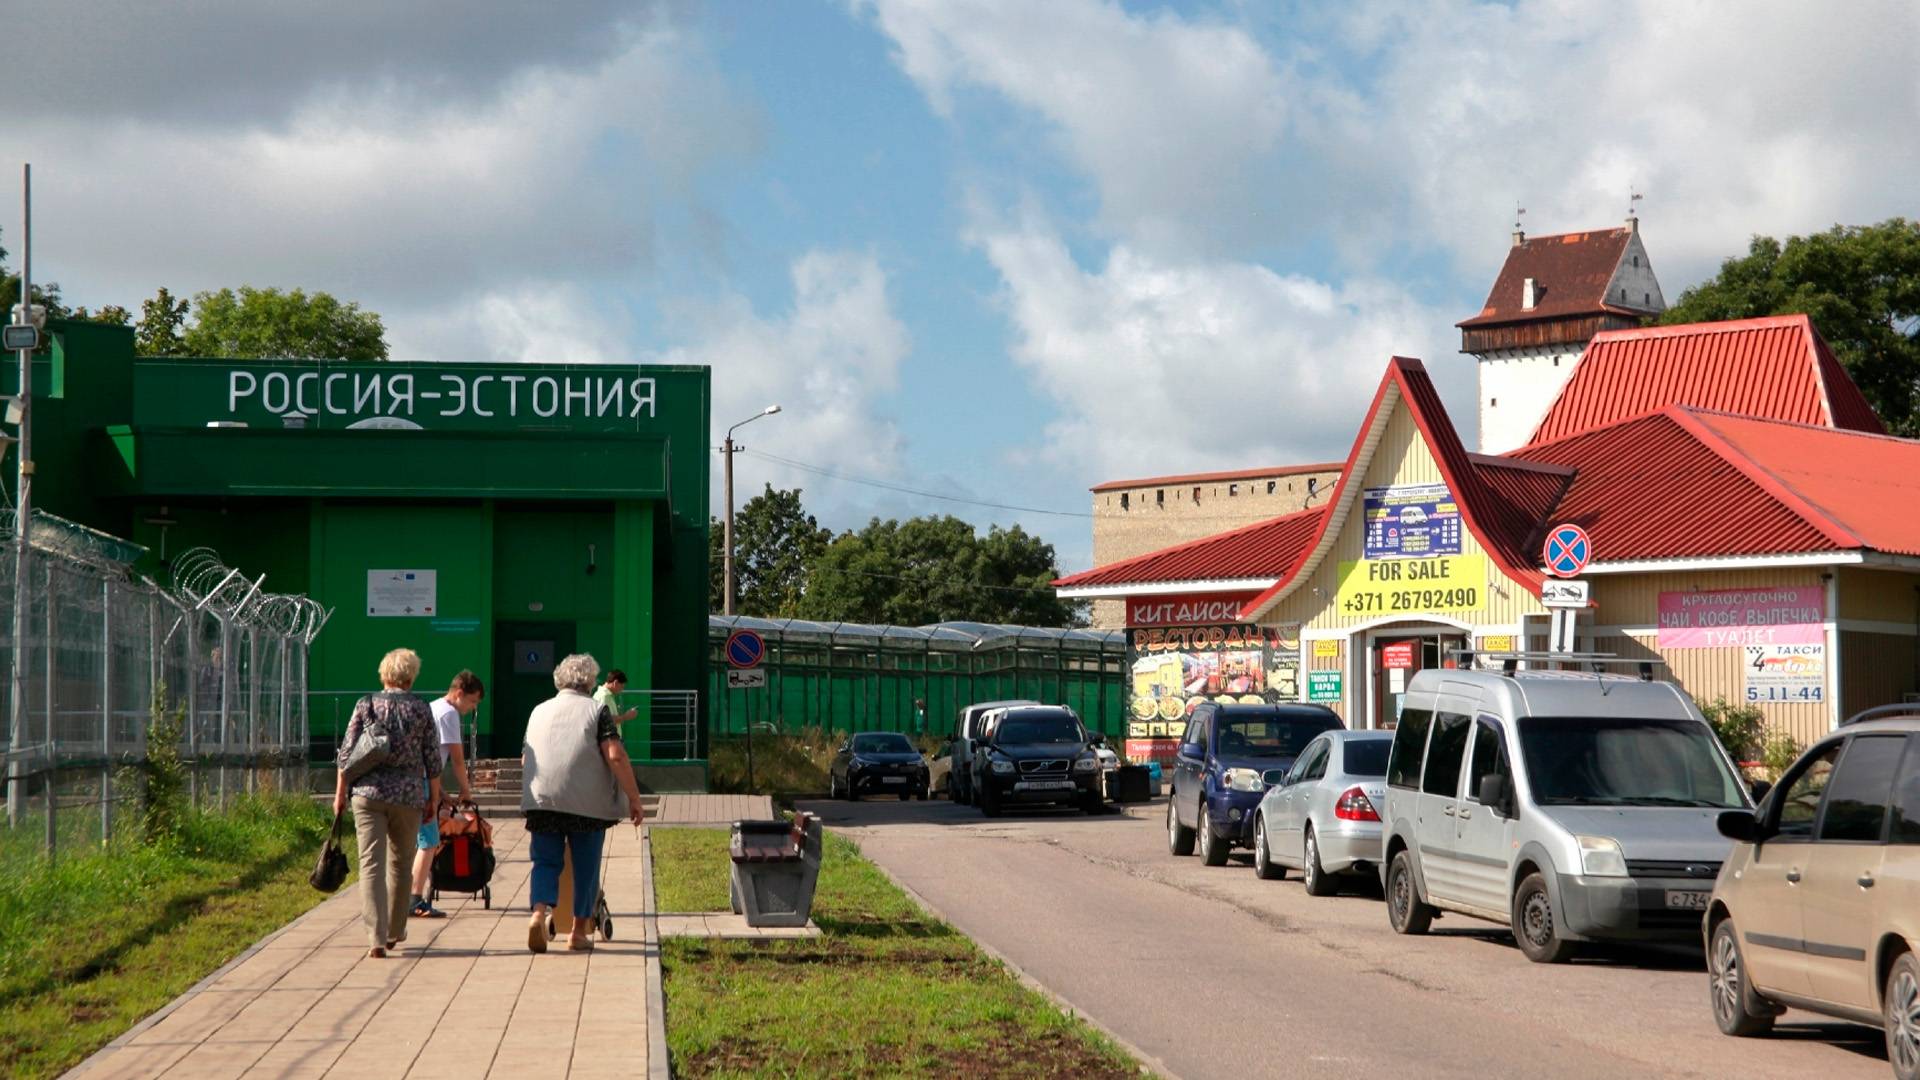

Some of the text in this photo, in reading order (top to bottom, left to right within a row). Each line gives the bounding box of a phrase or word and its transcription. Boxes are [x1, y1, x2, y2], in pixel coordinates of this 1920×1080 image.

[229, 370, 657, 418] РОССИЯ-ЭСТОНИЯ
[1369, 560, 1450, 581] FOR SALE
[1344, 588, 1477, 612] +371 26792490
[1682, 591, 1798, 606] КРУГЛОСУТОЧНО
[1747, 607, 1820, 625] ВЫПЕЧКА
[1133, 626, 1265, 651] РЕСТОРАН
[1704, 629, 1776, 645] ТУАЛЕТ
[1777, 646, 1821, 654] ТАКСИ
[1747, 686, 1822, 701] 5-11-44
